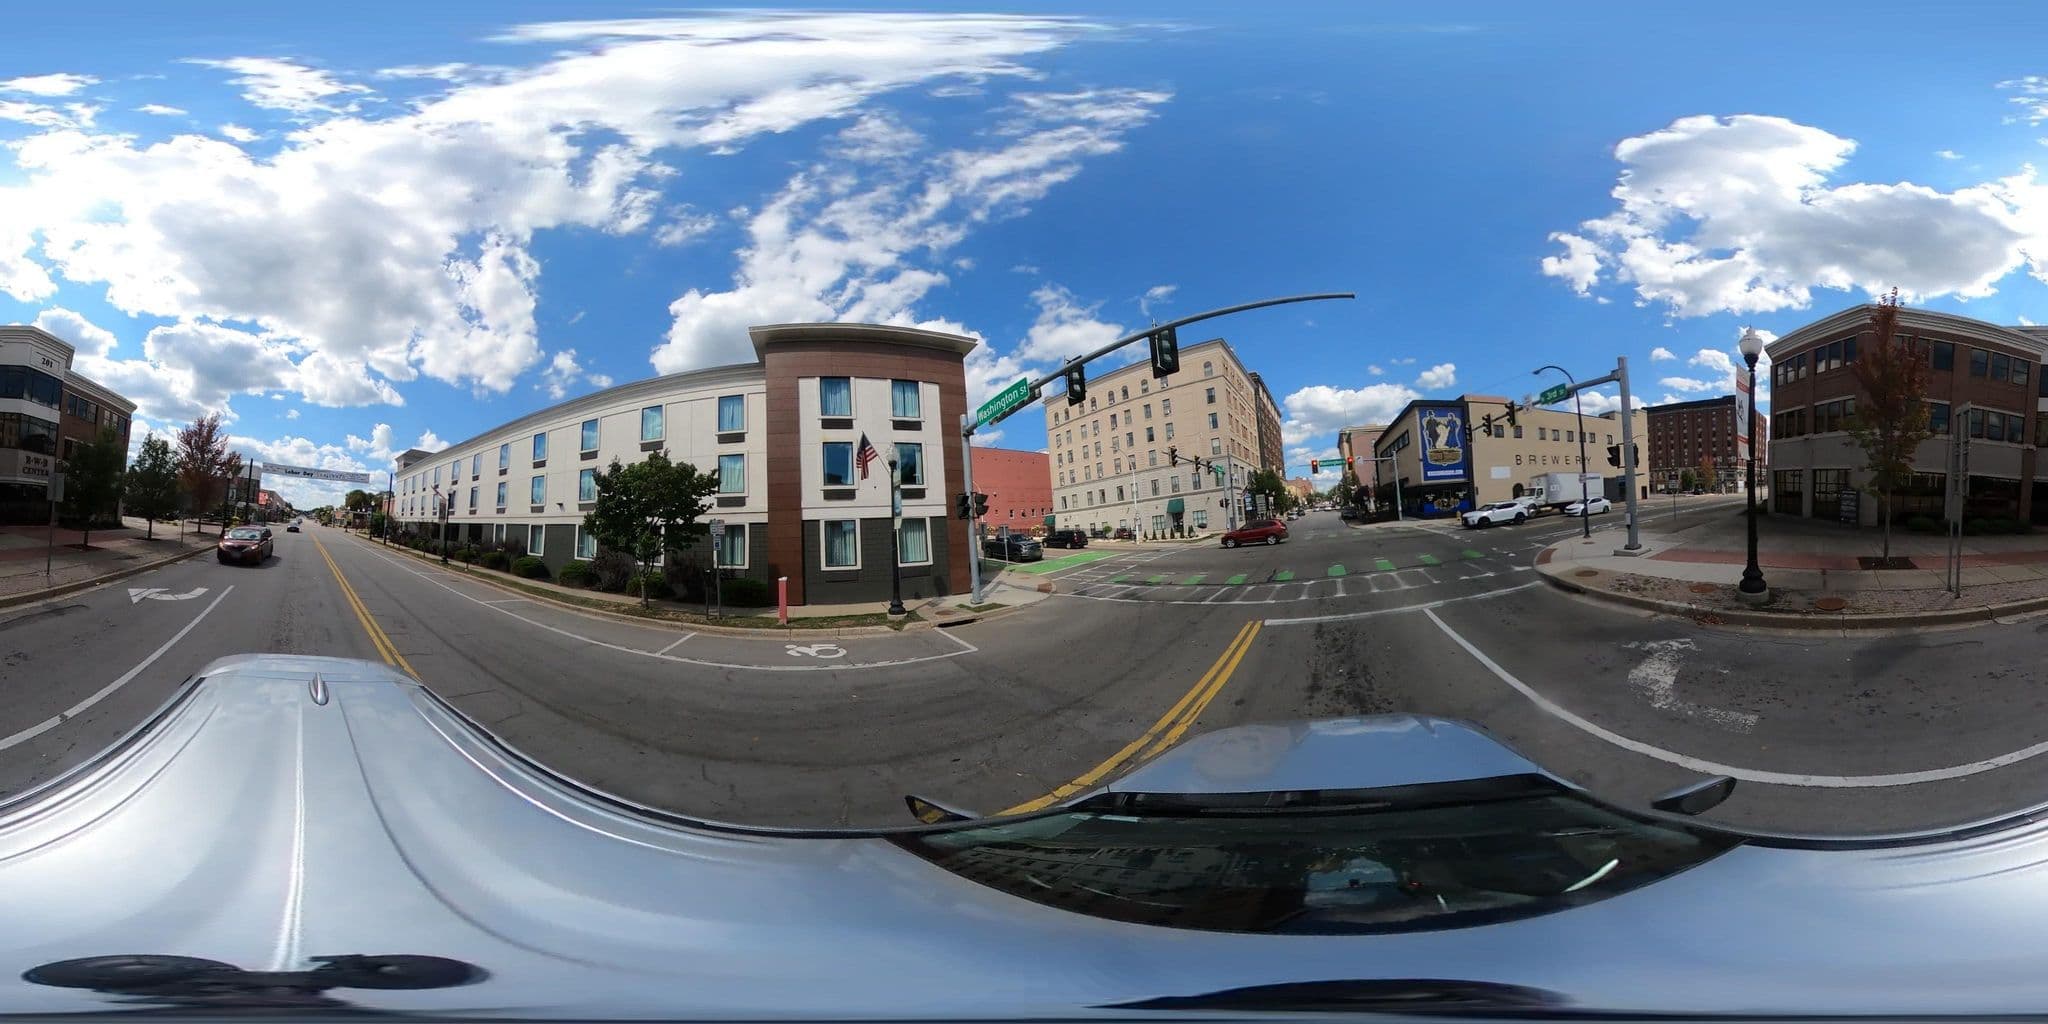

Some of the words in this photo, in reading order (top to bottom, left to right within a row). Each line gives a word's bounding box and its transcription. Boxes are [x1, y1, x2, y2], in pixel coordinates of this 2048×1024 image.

[41, 357, 53, 368] 201
[1546, 389, 1558, 400] 3rd
[978, 389, 1019, 422] Washington
[1019, 385, 1028, 395] St
[1515, 454, 1592, 466] BREWERY
[284, 468, 301, 476] Labor
[303, 470, 314, 478] Day
